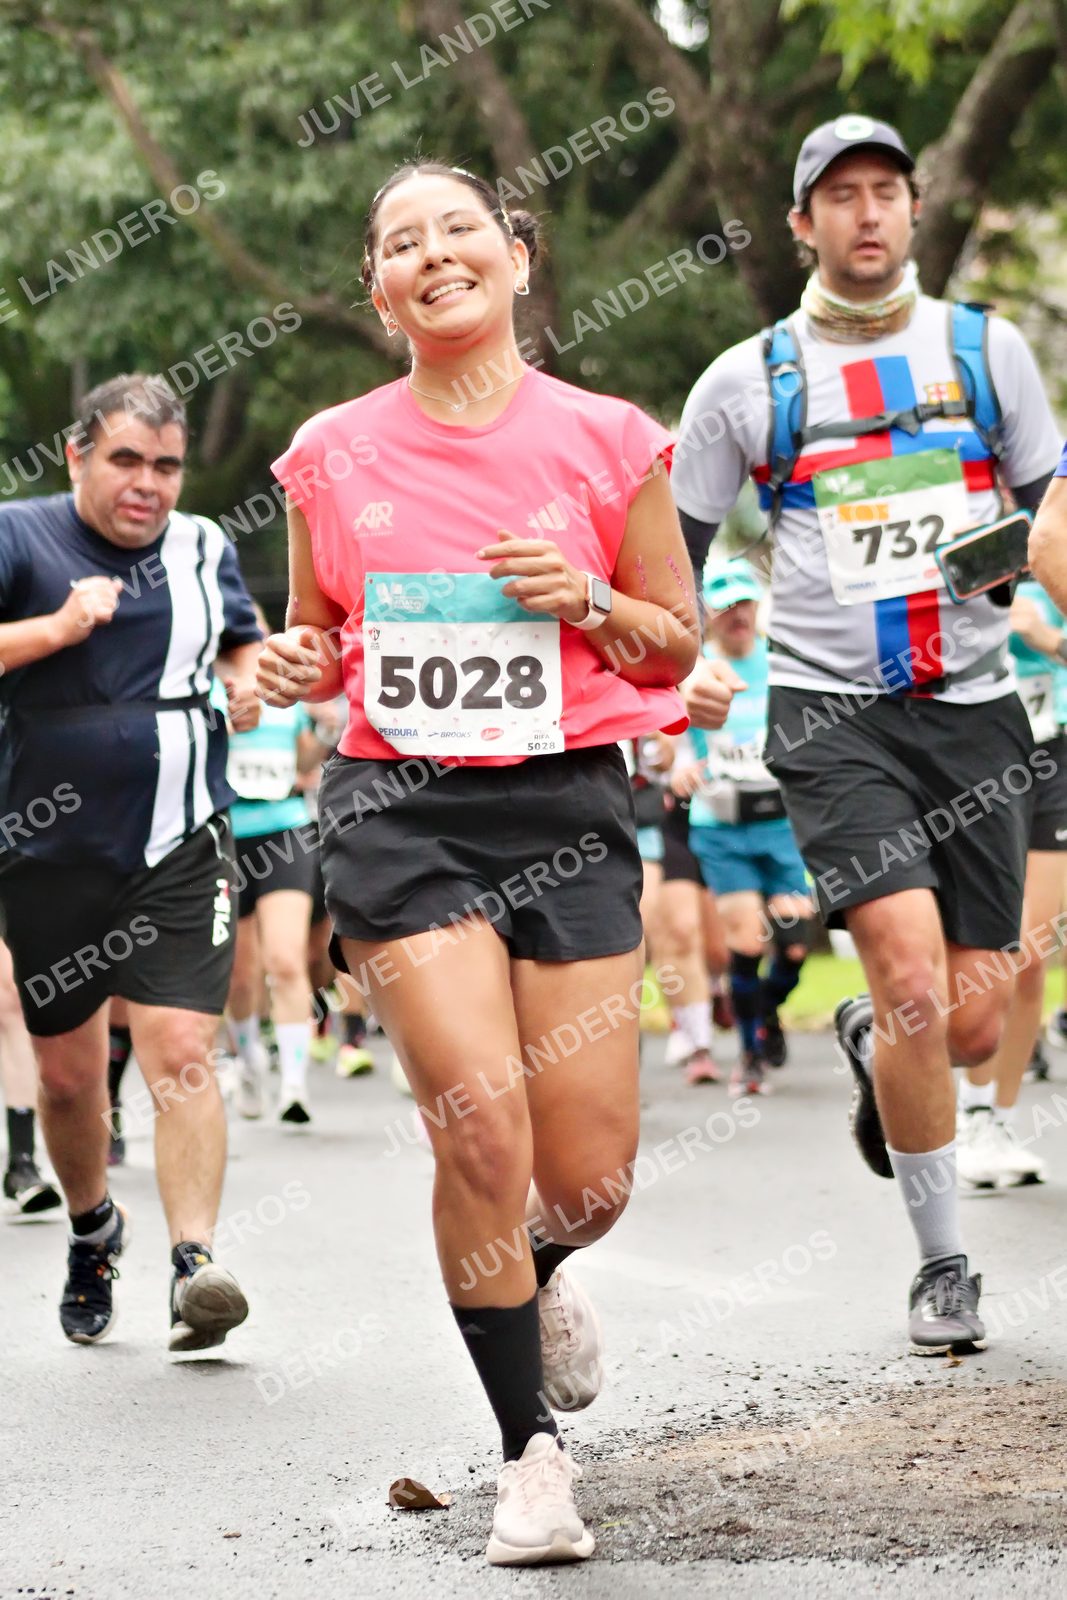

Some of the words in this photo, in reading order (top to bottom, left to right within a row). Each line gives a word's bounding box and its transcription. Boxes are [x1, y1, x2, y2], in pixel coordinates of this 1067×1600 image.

[853, 514, 944, 566] 732
[377, 655, 547, 710] 5028
[379, 728, 418, 737] PERDURA
[441, 731, 472, 739] BROOKS
[527, 742, 556, 751] 5028
